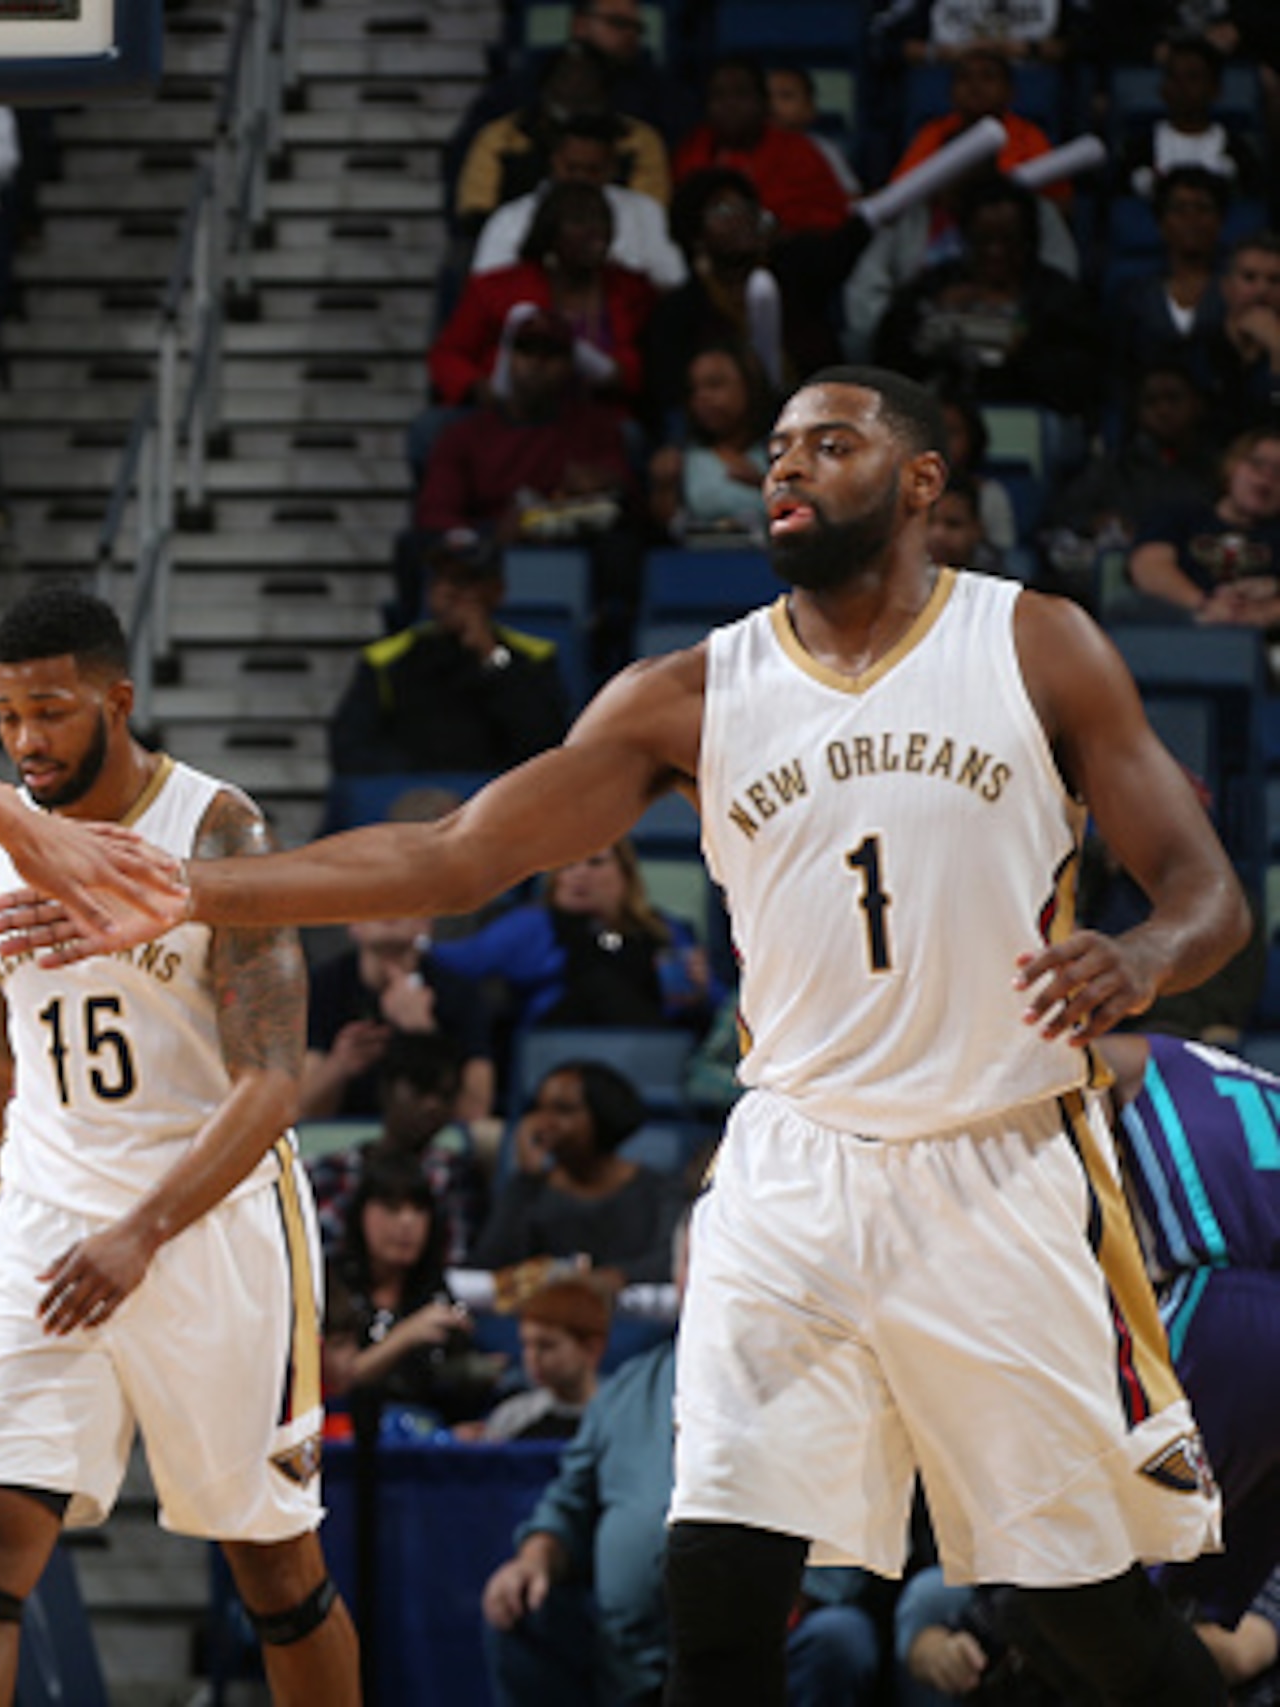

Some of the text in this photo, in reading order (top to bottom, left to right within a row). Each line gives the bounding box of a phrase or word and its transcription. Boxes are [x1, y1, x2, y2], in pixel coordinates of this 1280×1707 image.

[728, 731, 1013, 840] NEW ORLEANS
[845, 833, 891, 974] 1
[38, 995, 137, 1106] 15
[1213, 1075, 1280, 1170] 1
